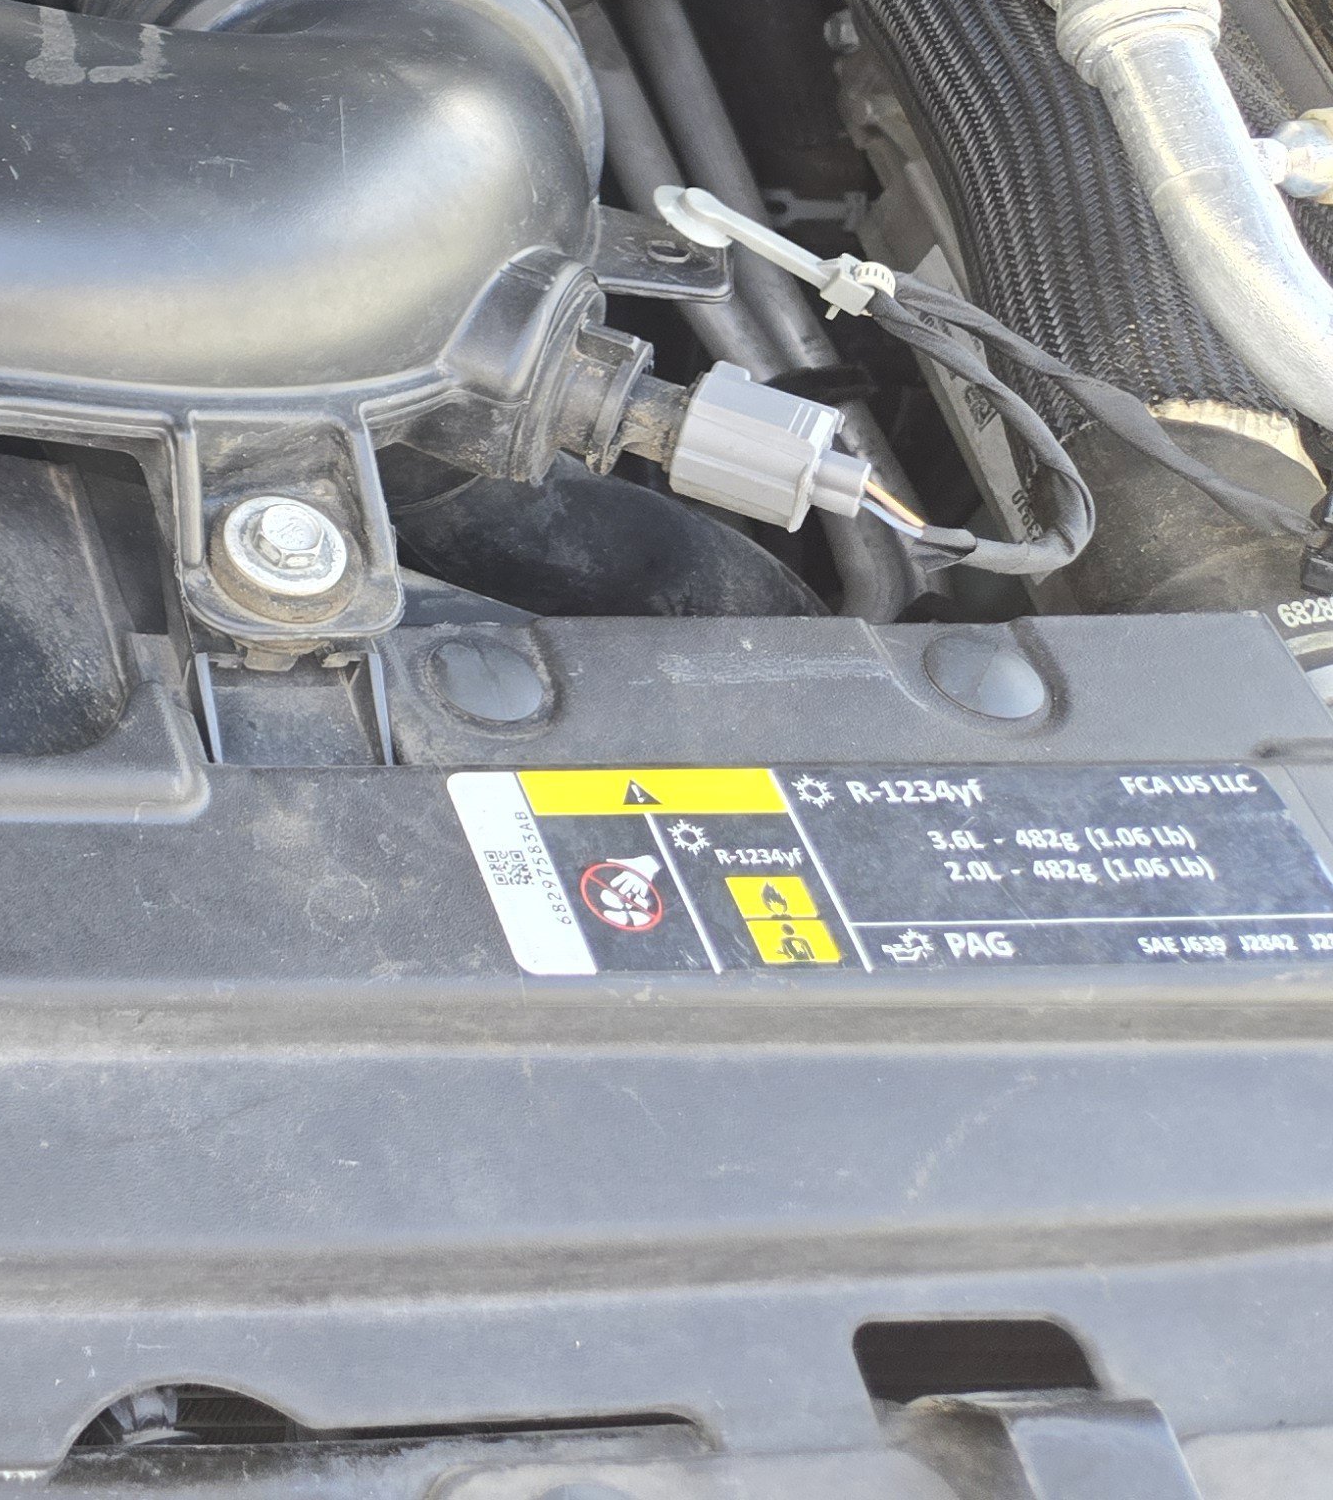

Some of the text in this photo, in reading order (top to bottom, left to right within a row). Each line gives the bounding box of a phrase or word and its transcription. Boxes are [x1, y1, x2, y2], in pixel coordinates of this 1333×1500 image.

[844, 777, 986, 809] R-1234yf
[1119, 773, 1259, 797] FCA US LLC
[926, 830, 985, 852] 3.6L
[1015, 827, 1081, 854] 482g
[1085, 826, 1153, 854] (1.06
[1156, 824, 1198, 852] Lb)
[514, 811, 572, 926] 68297583AB
[713, 847, 805, 868] R-1234yf
[944, 860, 1003, 882] 2.0L
[1033, 858, 1099, 885] 482g
[1103, 856, 1171, 885] (1.06
[1175, 855, 1217, 882] Lb)
[943, 930, 1018, 960] PAG
[1136, 937, 1180, 957] SAE
